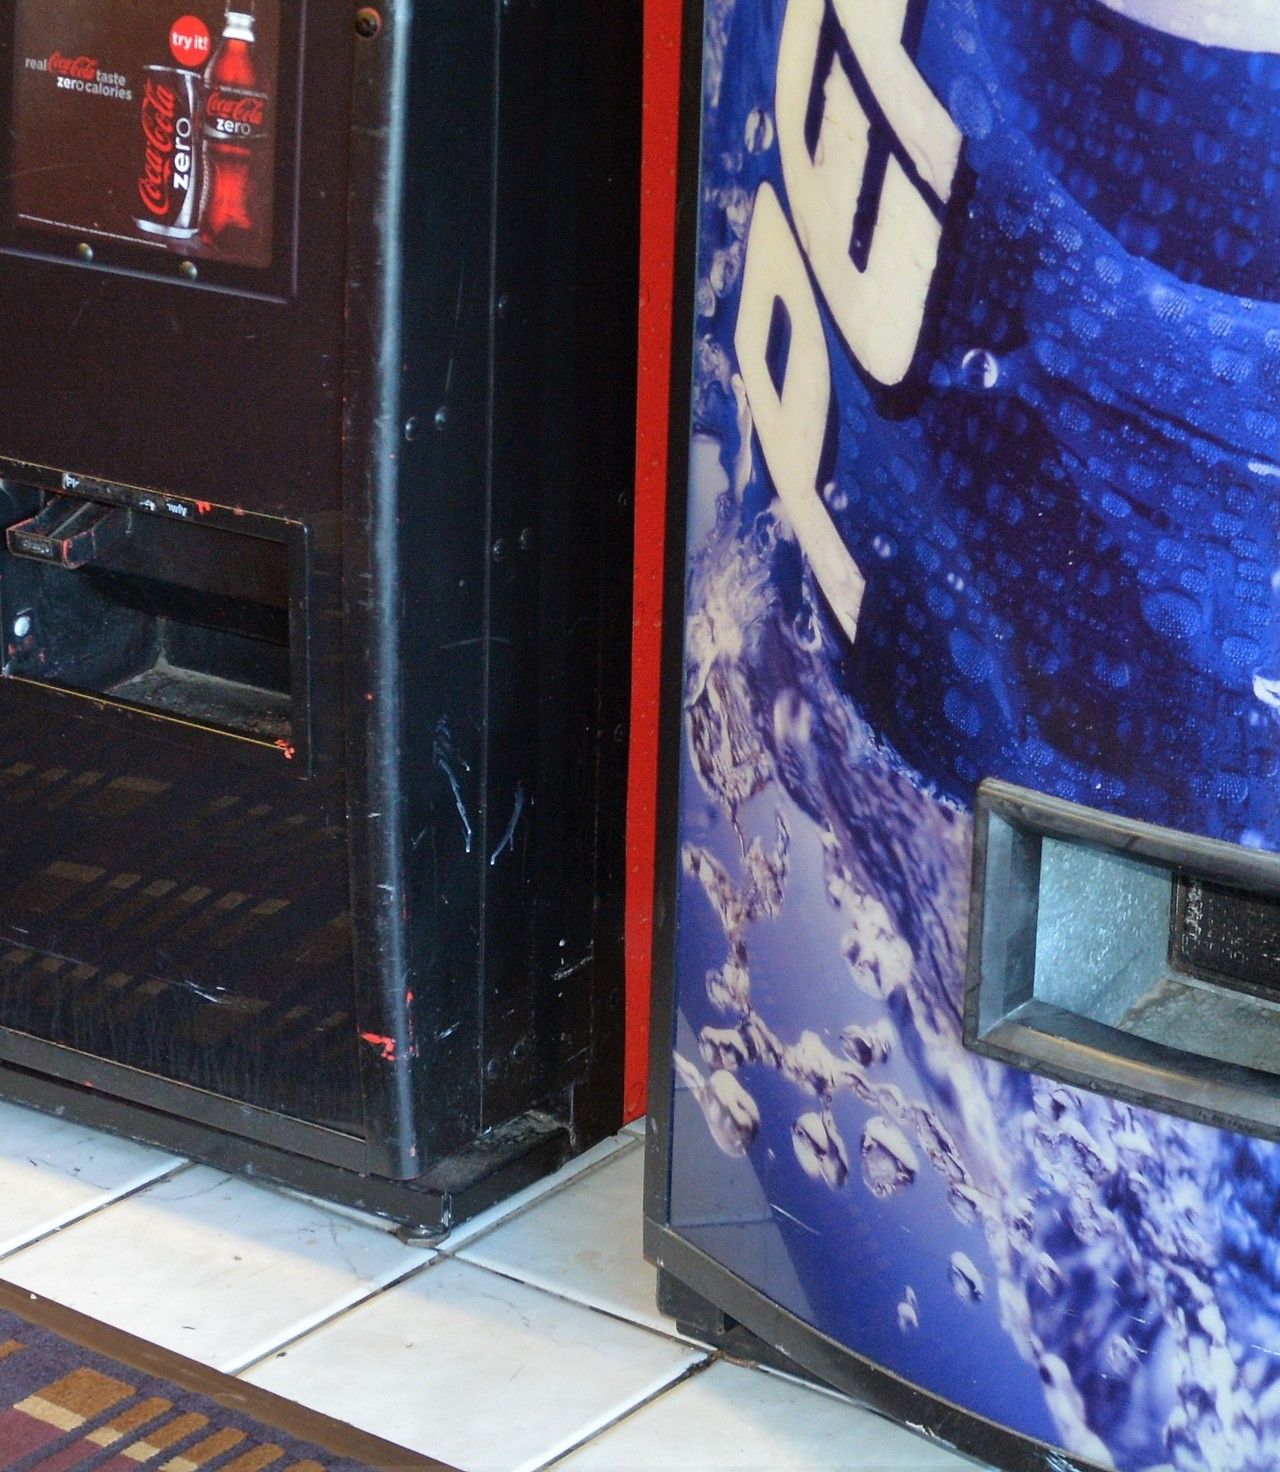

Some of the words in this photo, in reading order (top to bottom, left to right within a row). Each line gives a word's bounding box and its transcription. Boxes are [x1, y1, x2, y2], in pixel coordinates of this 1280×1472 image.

[172, 32, 192, 49] try
[194, 33, 208, 50] it!
[25, 57, 48, 71] real
[96, 69, 126, 86] taste
[57, 76, 85, 92] zero
[85, 80, 132, 101] calories
[206, 92, 266, 125] Coca-Cola
[216, 117, 252, 136] zero
[139, 79, 175, 216] Coca-Cola
[174, 117, 192, 190] zero
